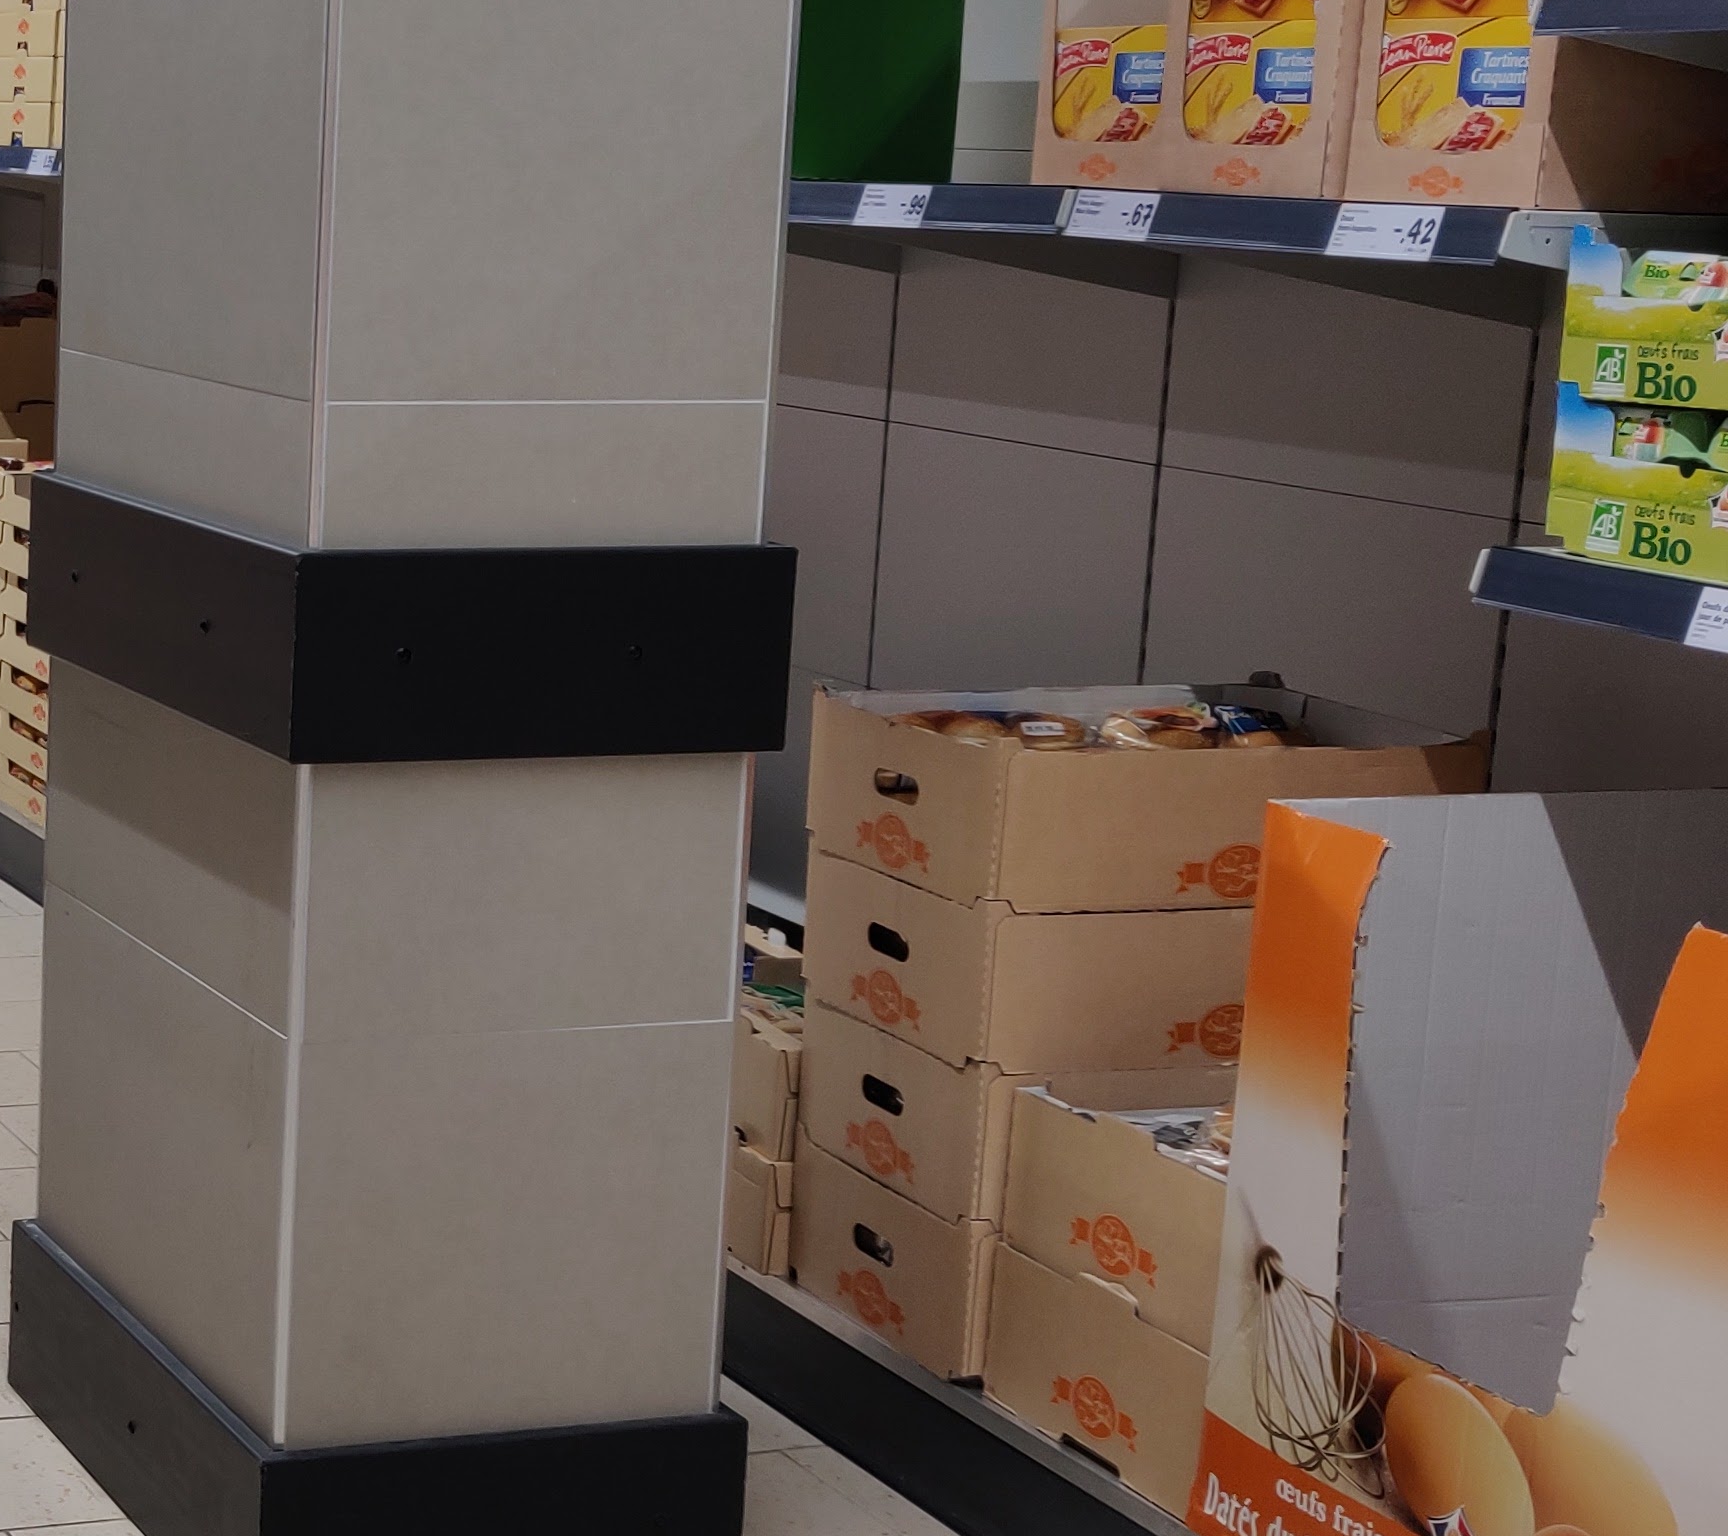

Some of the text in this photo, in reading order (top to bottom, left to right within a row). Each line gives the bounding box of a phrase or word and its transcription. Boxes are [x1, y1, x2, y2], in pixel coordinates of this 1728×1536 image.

[1412, 34, 1454, 59] Pierre
[1121, 202, 1155, 228] -.67
[1393, 217, 1436, 245] -.42
[1644, 264, 1670, 279] Bio
[1672, 341, 1699, 361] frais
[1595, 354, 1625, 385] AB
[1634, 361, 1697, 403] Bio
[1591, 513, 1618, 539] AB
[1669, 505, 1696, 526] frais
[1628, 520, 1692, 566] Bio
[1275, 1478, 1327, 1523] œufs
